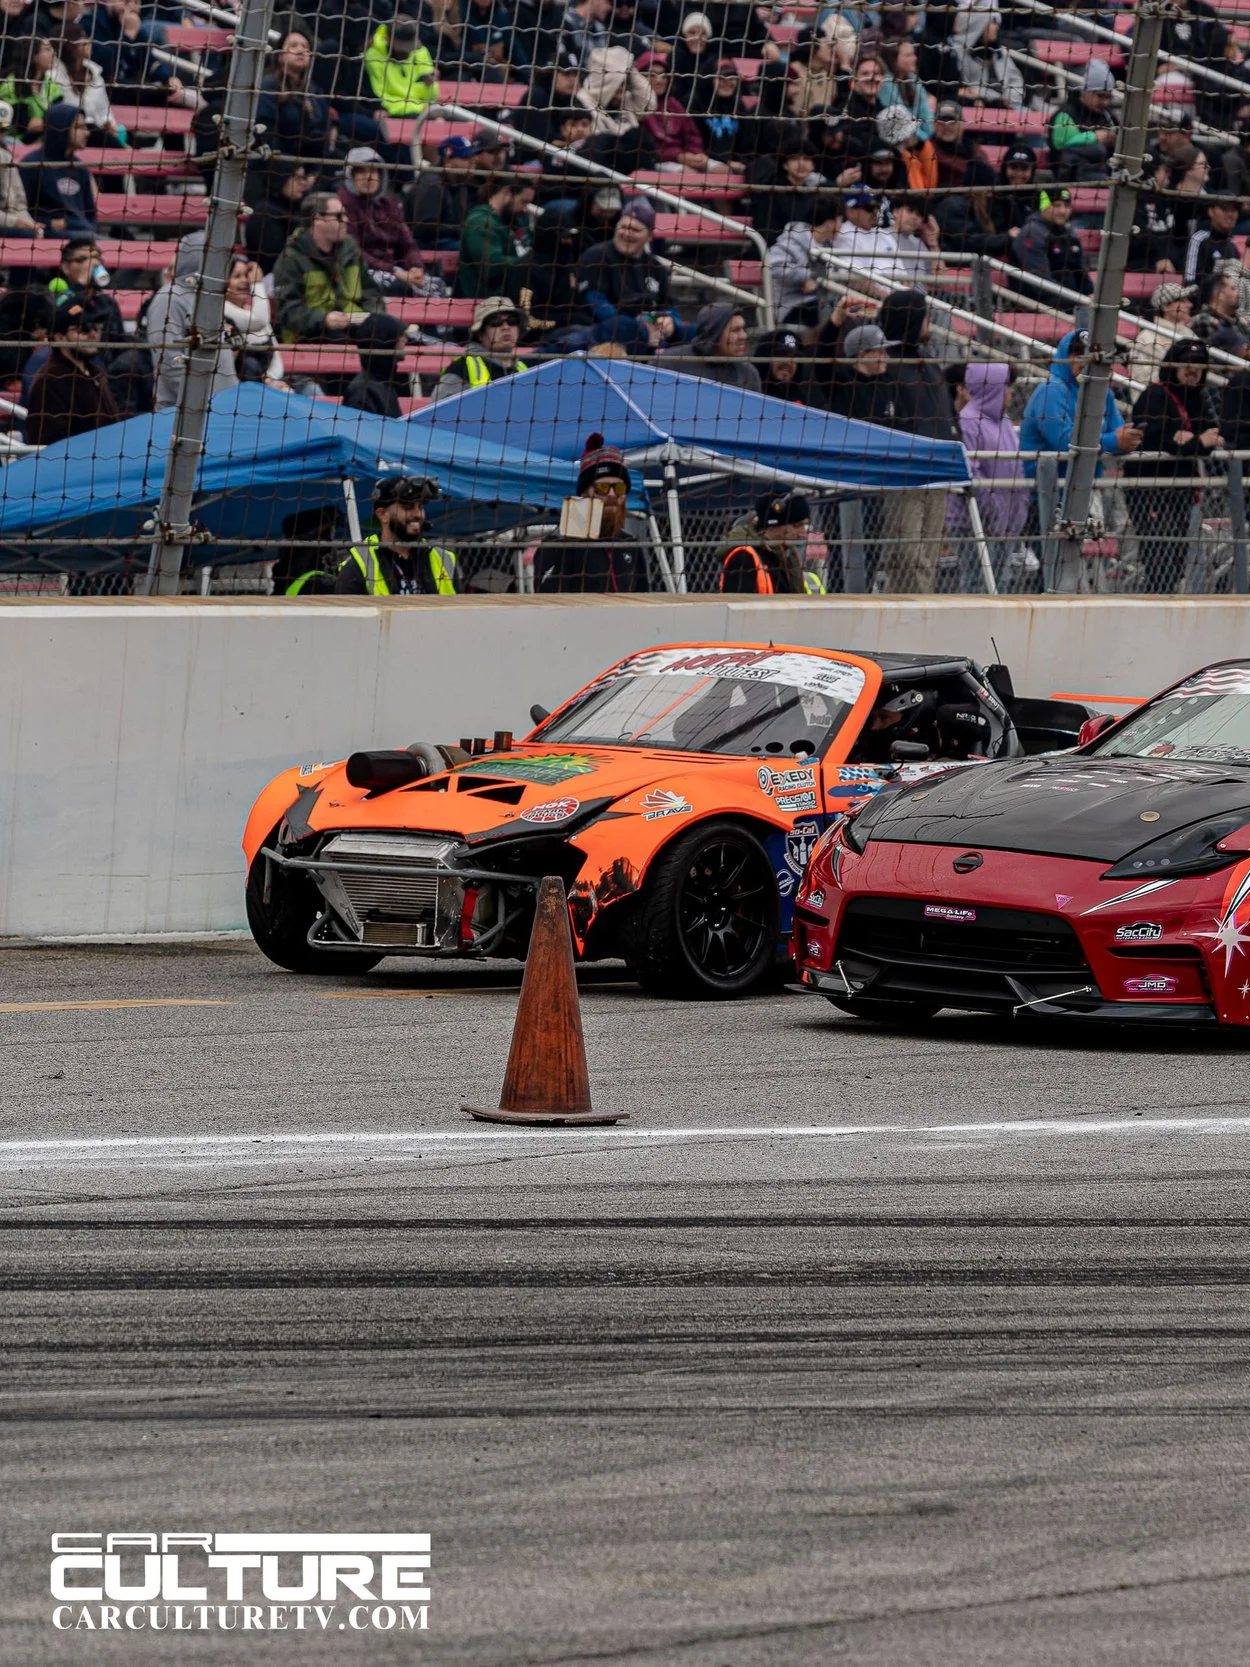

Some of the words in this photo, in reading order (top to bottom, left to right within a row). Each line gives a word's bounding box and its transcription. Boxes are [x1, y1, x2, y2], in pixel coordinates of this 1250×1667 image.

[771, 769, 814, 786] EXEDY
[532, 801, 570, 811] NGK
[643, 805, 691, 820] BRAVE
[1115, 927, 1162, 939] SacCity
